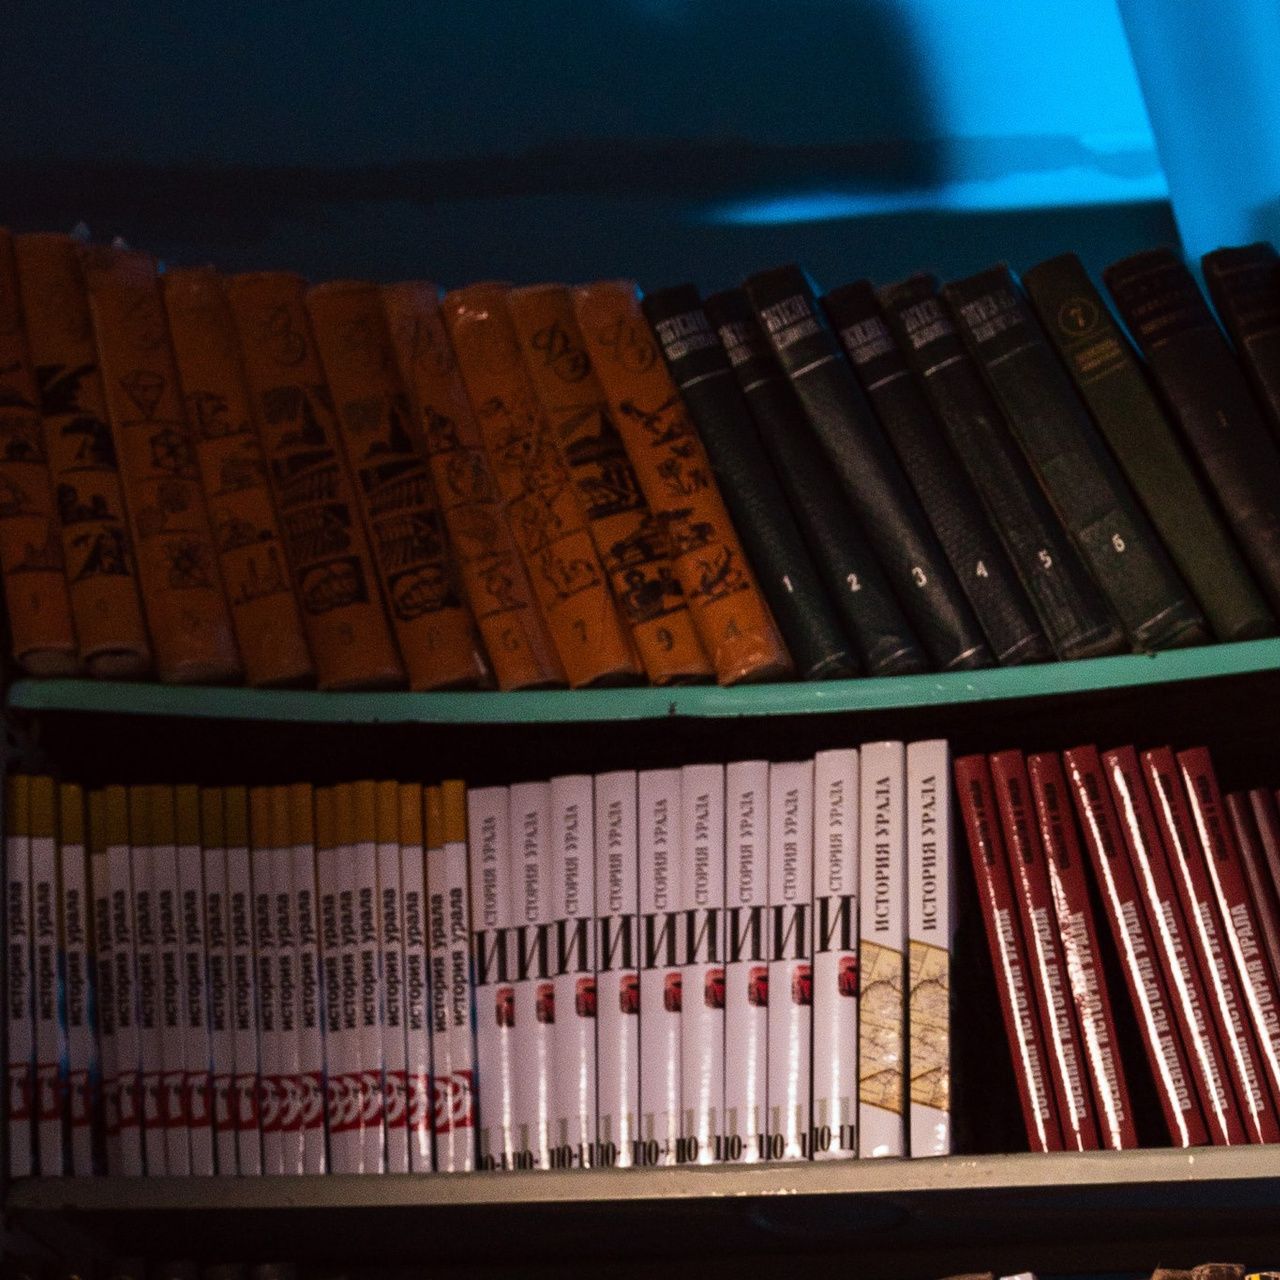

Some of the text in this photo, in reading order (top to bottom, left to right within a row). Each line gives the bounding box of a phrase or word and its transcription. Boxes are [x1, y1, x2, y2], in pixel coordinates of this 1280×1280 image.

[1112, 533, 1126, 553] 6
[975, 560, 989, 579] 4
[1038, 550, 1052, 569] 5
[782, 574, 794, 593] 1
[846, 573, 862, 592] 2
[912, 566, 927, 588] 3
[656, 625, 674, 651] 9
[875, 776, 891, 933] ИСТОРИЯ УРАЛА
[921, 775, 937, 931] ИСТОРИЯ УРАЛА
[1229, 902, 1260, 958] УРАЛА
